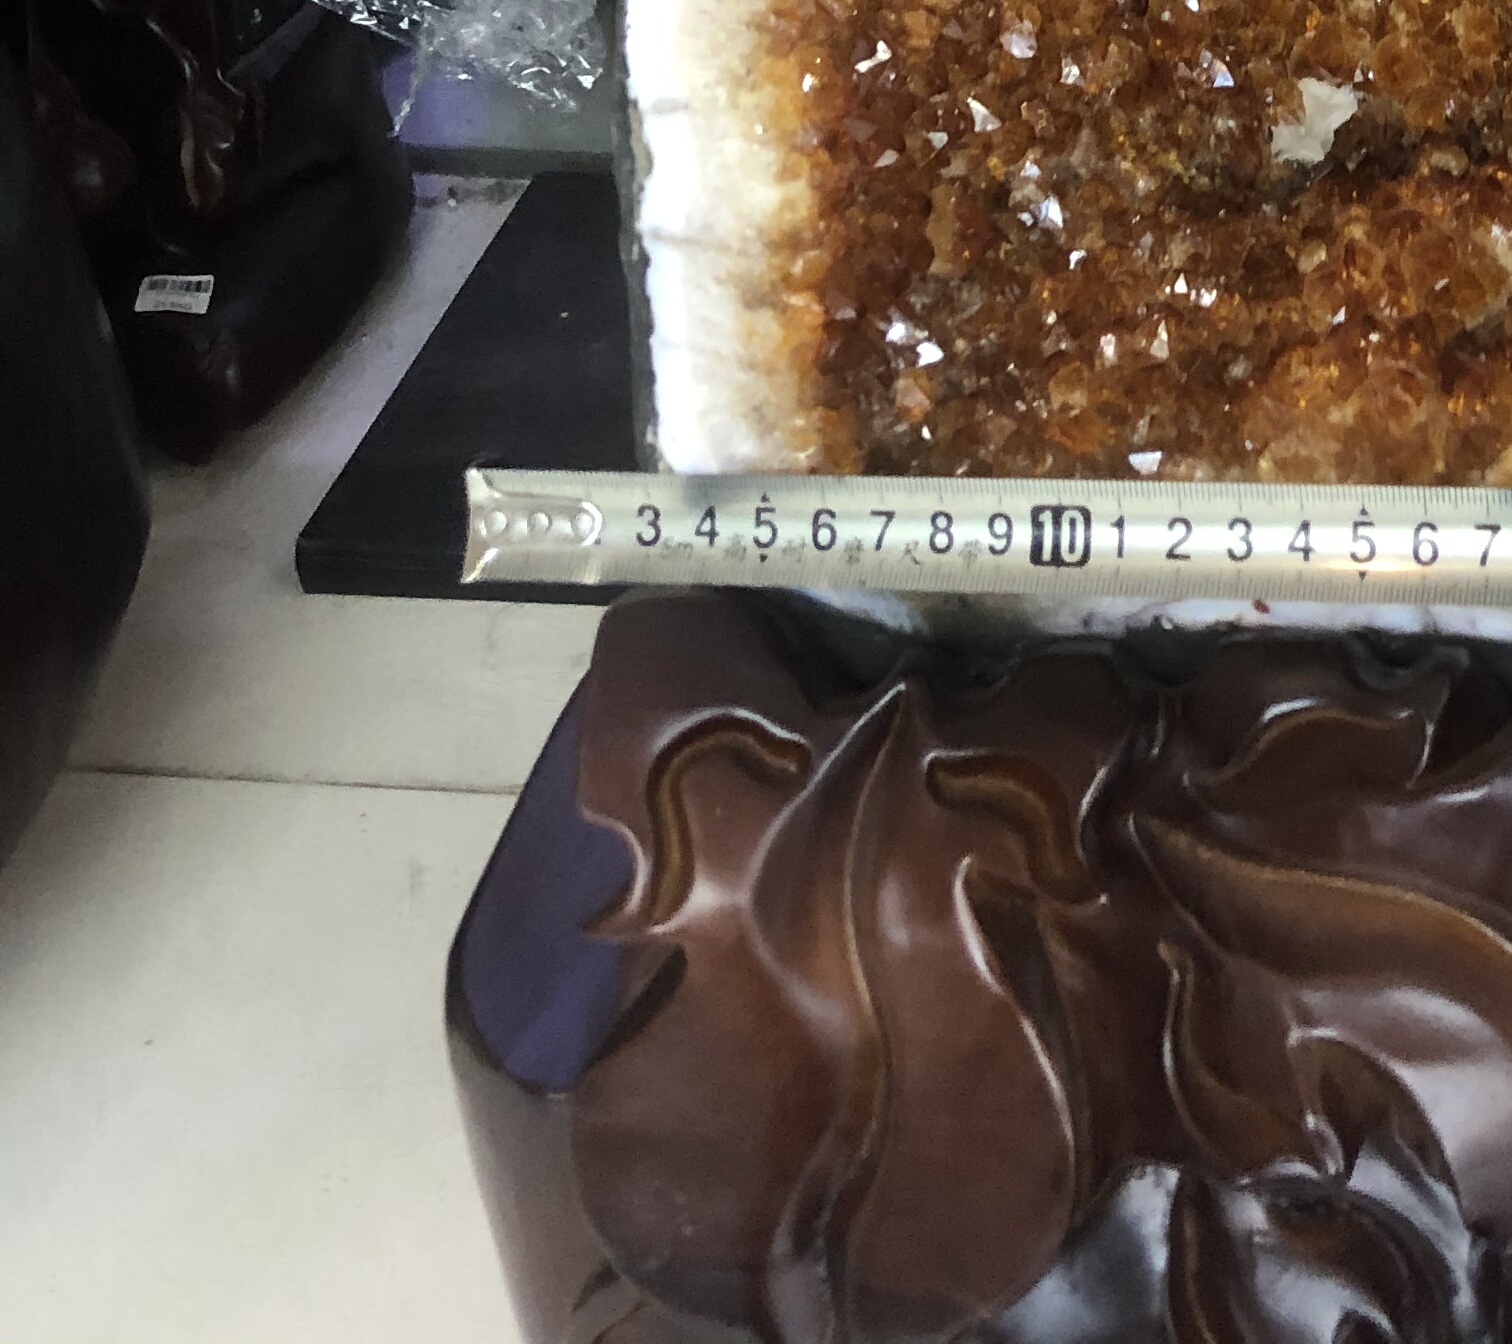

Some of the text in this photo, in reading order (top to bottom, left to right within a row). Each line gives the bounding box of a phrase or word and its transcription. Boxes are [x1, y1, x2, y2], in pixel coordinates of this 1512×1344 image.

[636, 503, 662, 547] 3
[694, 505, 720, 548] 4
[752, 506, 778, 549] 5
[811, 508, 838, 551] 6
[868, 509, 896, 552] 7
[929, 510, 954, 554] 8
[987, 512, 1014, 556] 9
[1037, 510, 1086, 562] 10
[1110, 516, 1124, 558] 1
[1165, 518, 1192, 560] 2
[1227, 519, 1253, 562] 3
[1287, 520, 1316, 561] 4
[1350, 520, 1376, 563] 5
[1412, 522, 1439, 565] 6
[1474, 524, 1501, 566] 7
